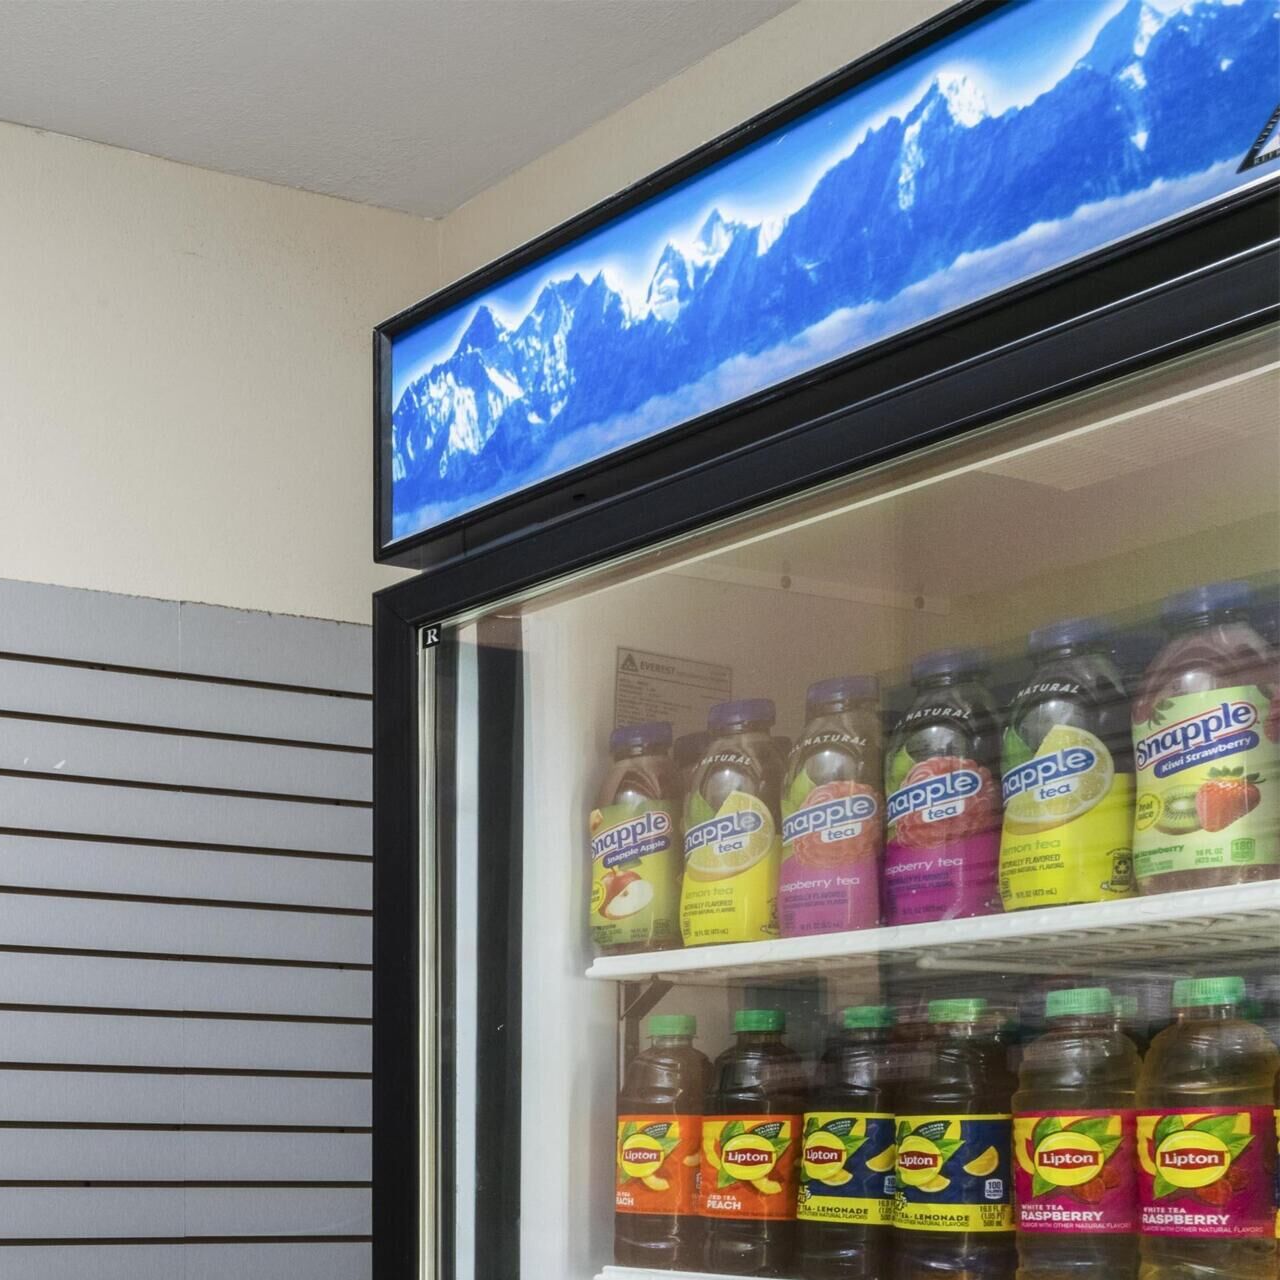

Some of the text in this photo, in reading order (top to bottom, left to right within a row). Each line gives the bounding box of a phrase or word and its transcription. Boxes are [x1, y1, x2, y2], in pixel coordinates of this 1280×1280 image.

[1017, 682, 1080, 701] NATURAL
[906, 707, 973, 720] NATURAL
[803, 733, 868, 747] NATURAL
[1136, 703, 1252, 767] Snapple
[1162, 735, 1251, 773] Kiwi Strawberry
[1003, 751, 1087, 797] napple
[887, 773, 976, 820] napple
[1039, 782, 1072, 800] tea
[927, 804, 959, 820] tea
[827, 825, 855, 841] tea
[607, 839, 666, 865] Snapple Apple
[718, 841, 744, 854] tea
[937, 857, 963, 867] tea
[836, 876, 860, 887] tea
[624, 1151, 657, 1161] Lipton
[728, 1152, 769, 1162] Lipton
[806, 1150, 838, 1162] Lipton
[899, 1154, 934, 1166] Lipton
[1042, 1152, 1094, 1166] Lipton
[1164, 1152, 1219, 1166] Lipton
[987, 1181, 1001, 1190] 100
[706, 1200, 741, 1210] PEACH
[817, 1207, 869, 1215] LEMONADE
[914, 1214, 970, 1222] LEMONADE
[1021, 1210, 1103, 1222] RASPBERRY
[1142, 1213, 1229, 1225] RASPBERRY
